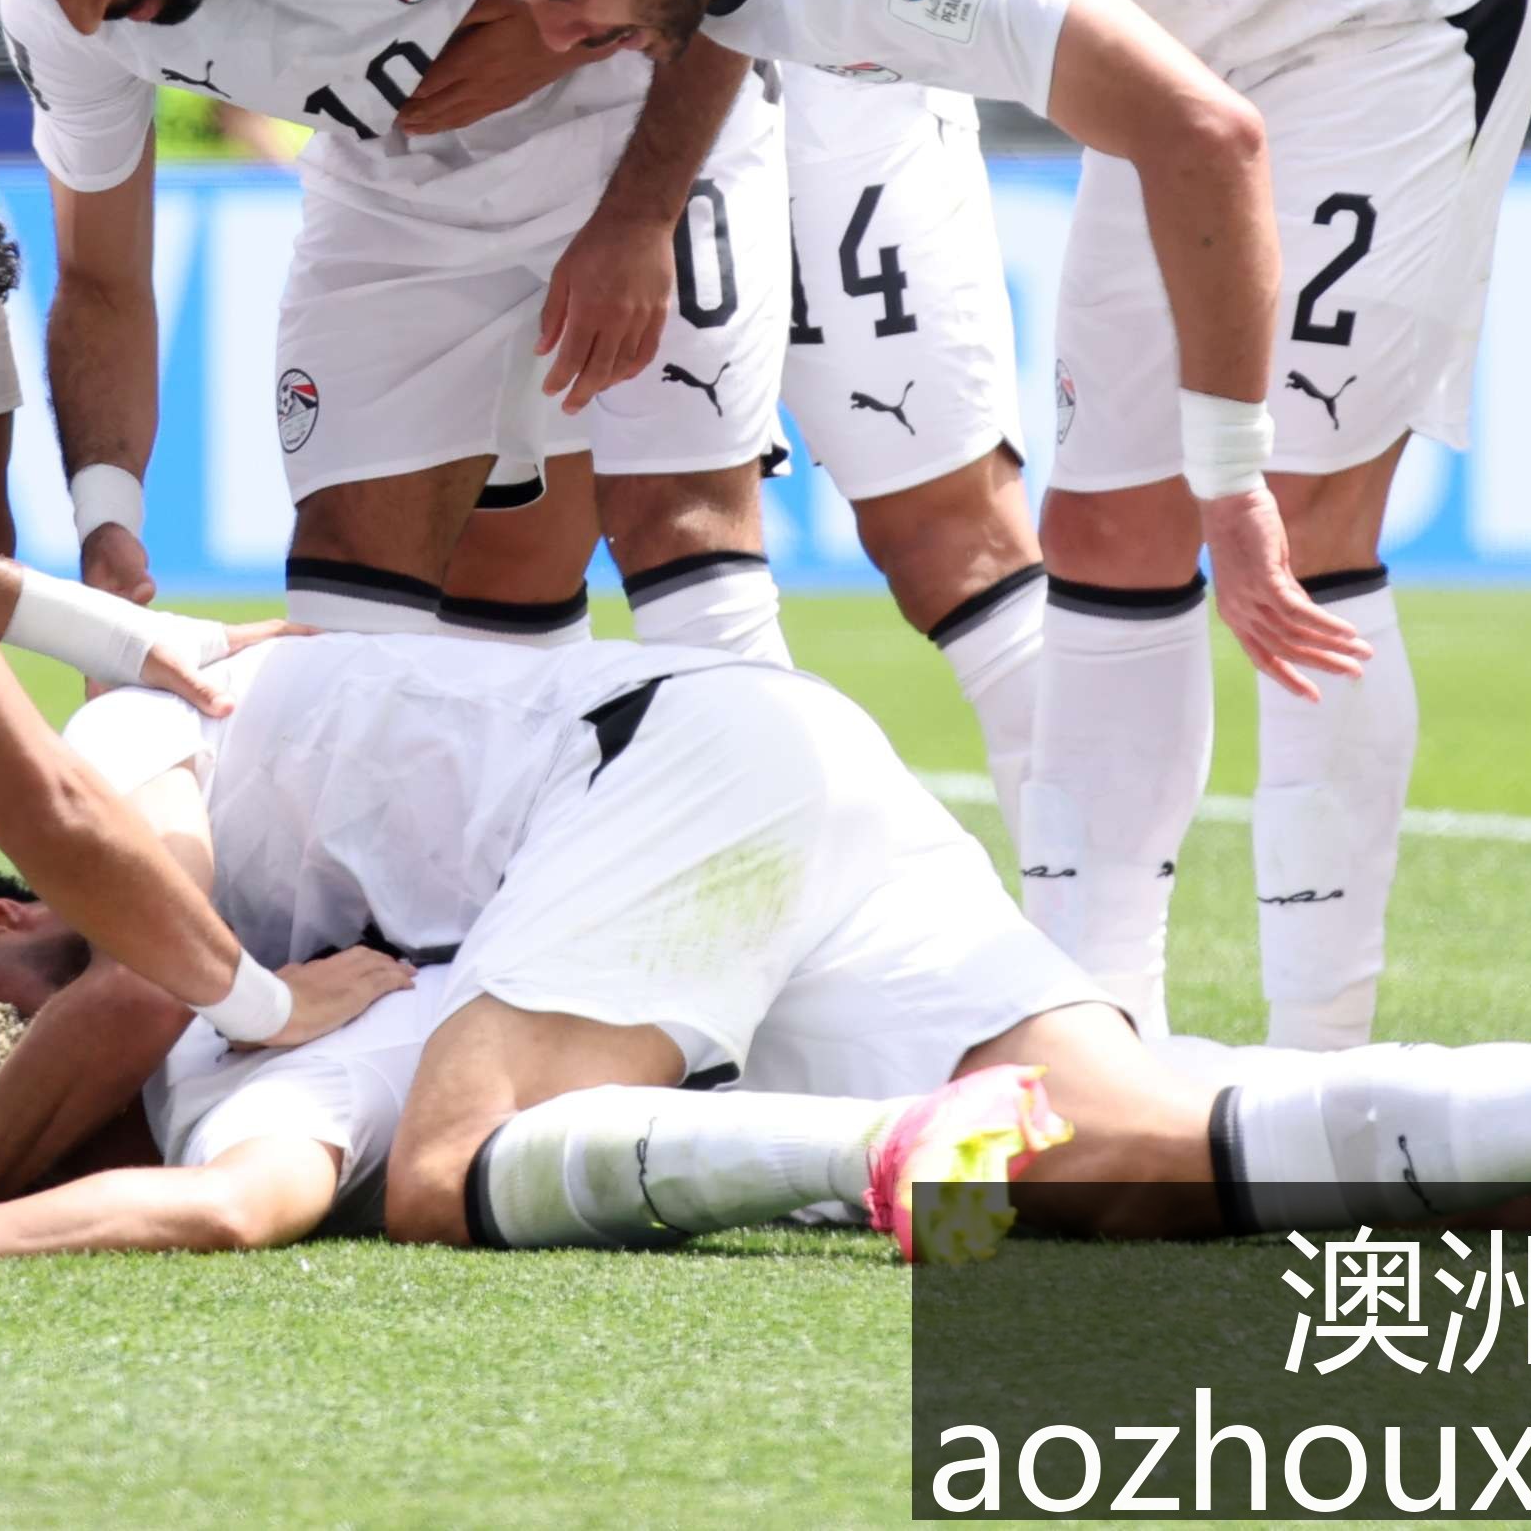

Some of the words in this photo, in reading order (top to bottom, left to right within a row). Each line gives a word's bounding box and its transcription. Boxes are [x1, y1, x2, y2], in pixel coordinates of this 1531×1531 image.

[303, 37, 435, 140] 10
[673, 178, 738, 329] 0
[1290, 191, 1377, 347] 2
